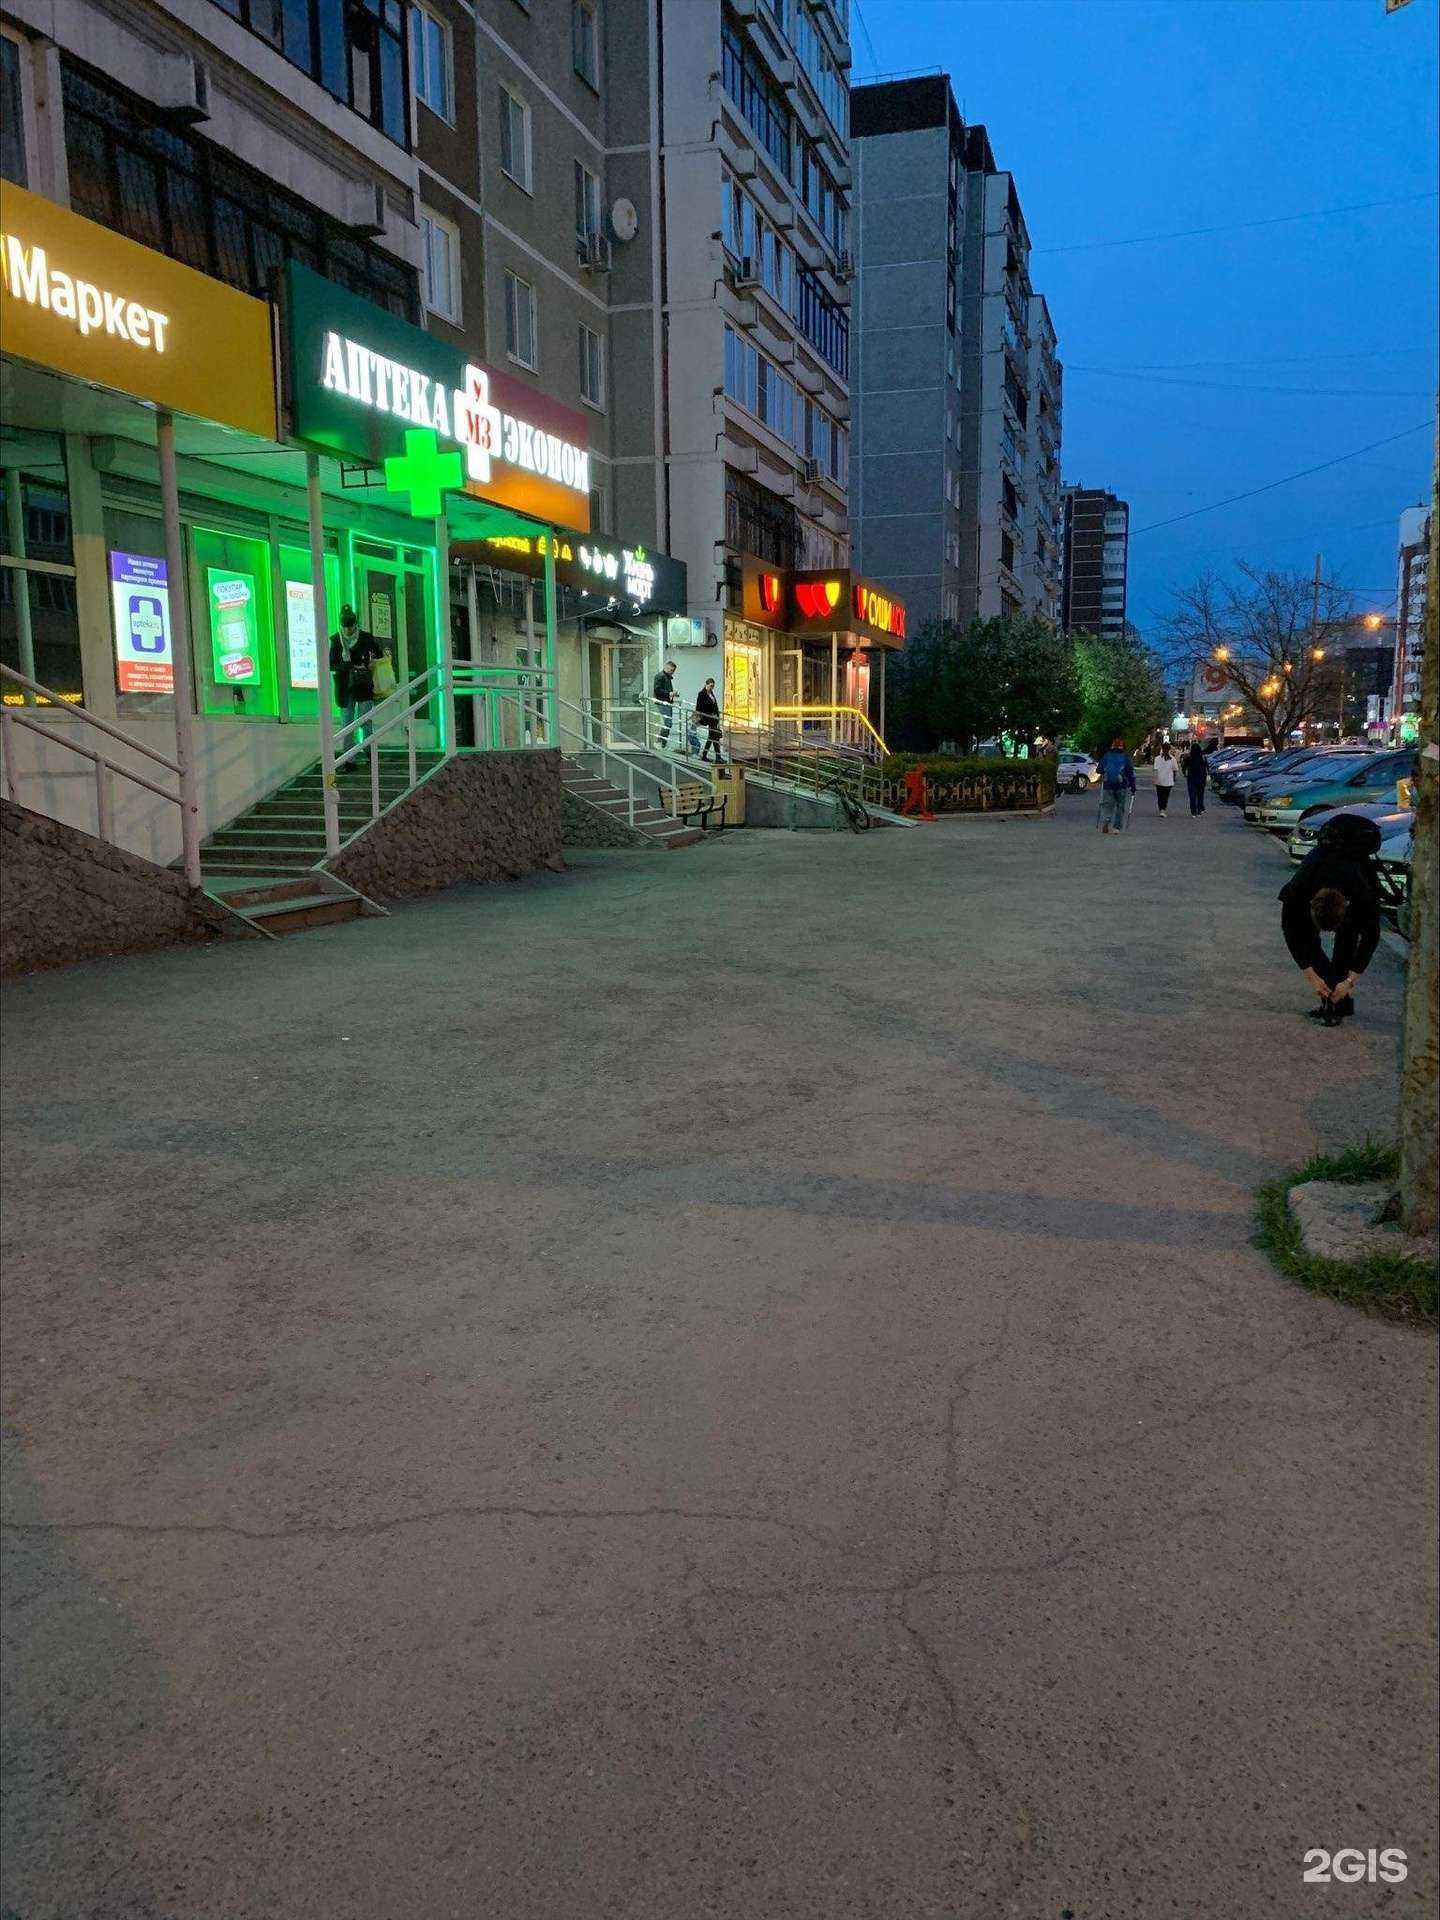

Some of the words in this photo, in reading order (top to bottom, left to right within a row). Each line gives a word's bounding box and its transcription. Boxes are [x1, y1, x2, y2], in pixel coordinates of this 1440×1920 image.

[5, 234, 168, 354] Маркет
[324, 330, 451, 437] АПТЕКА
[503, 413, 591, 494] ЭКОНОМ
